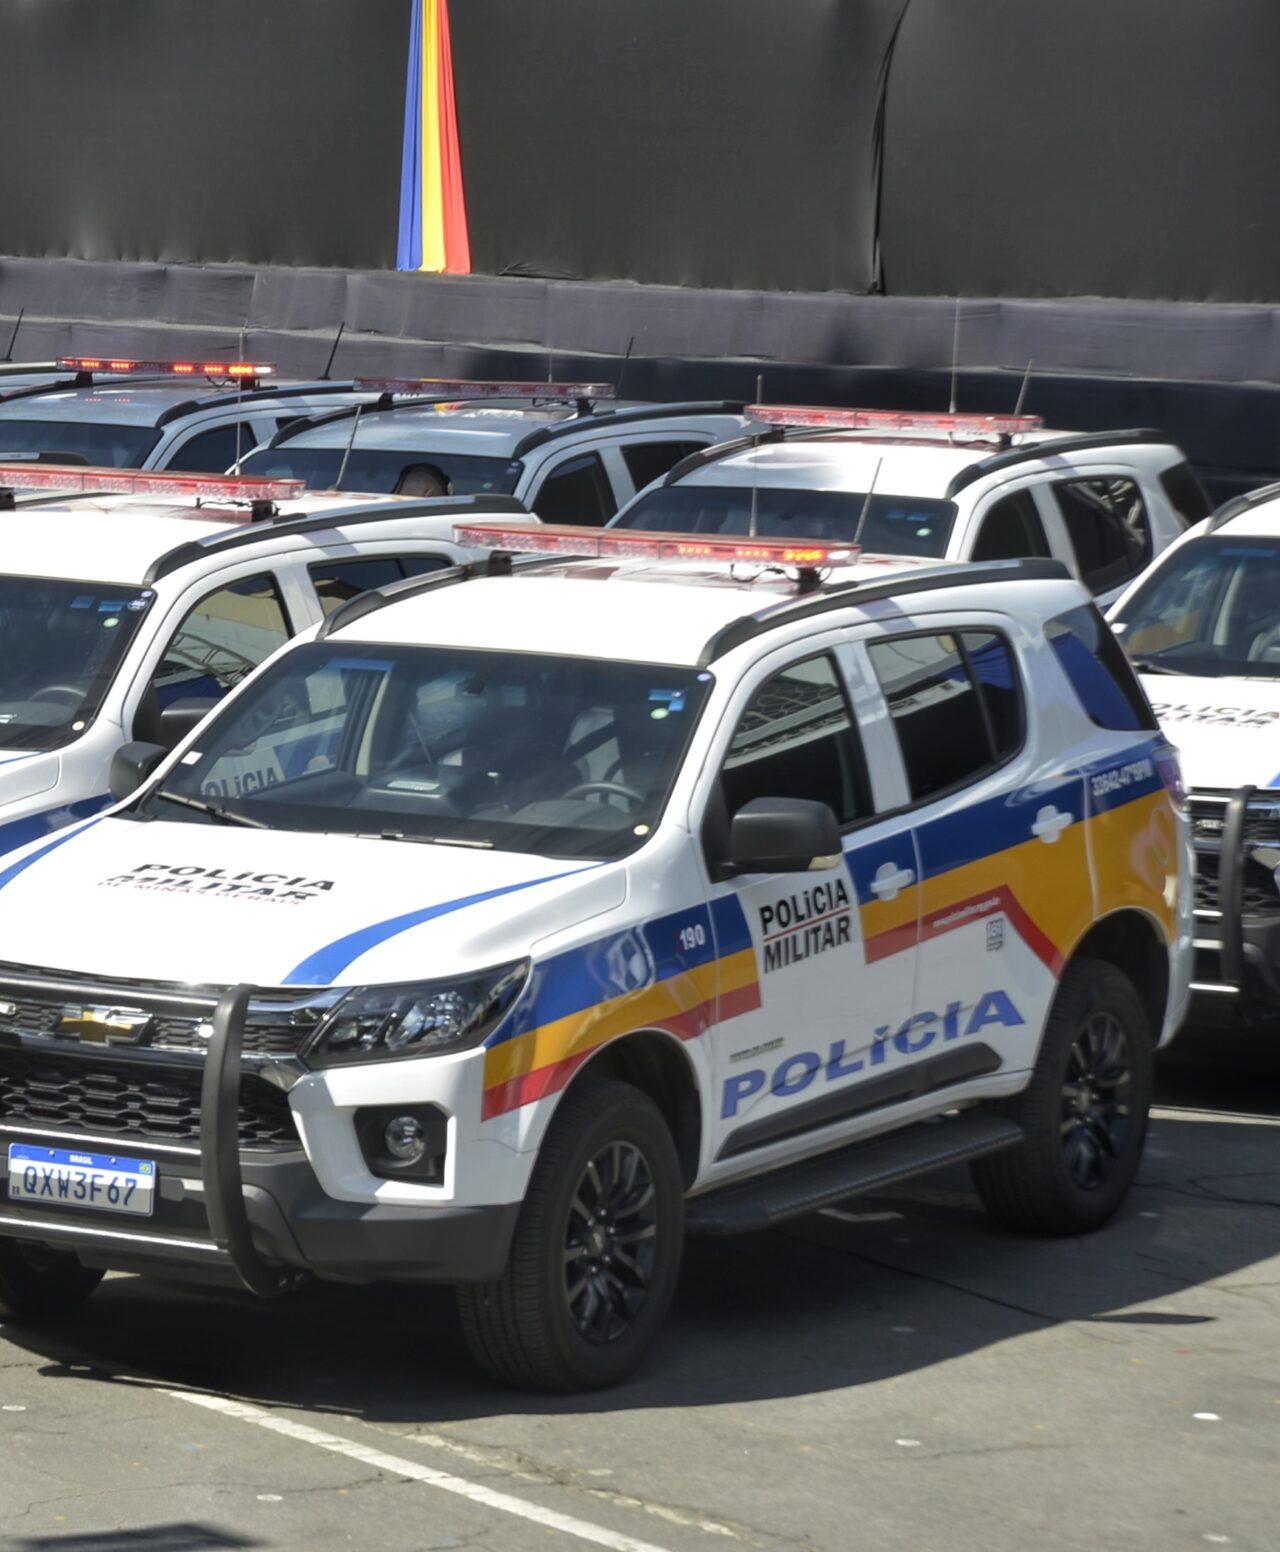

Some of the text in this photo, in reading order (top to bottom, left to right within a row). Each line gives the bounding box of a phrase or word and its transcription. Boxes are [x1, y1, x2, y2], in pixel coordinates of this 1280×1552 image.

[679, 923, 706, 951] 190
[764, 915, 851, 974] MILITAR
[23, 1165, 138, 1206] QXW3F67
